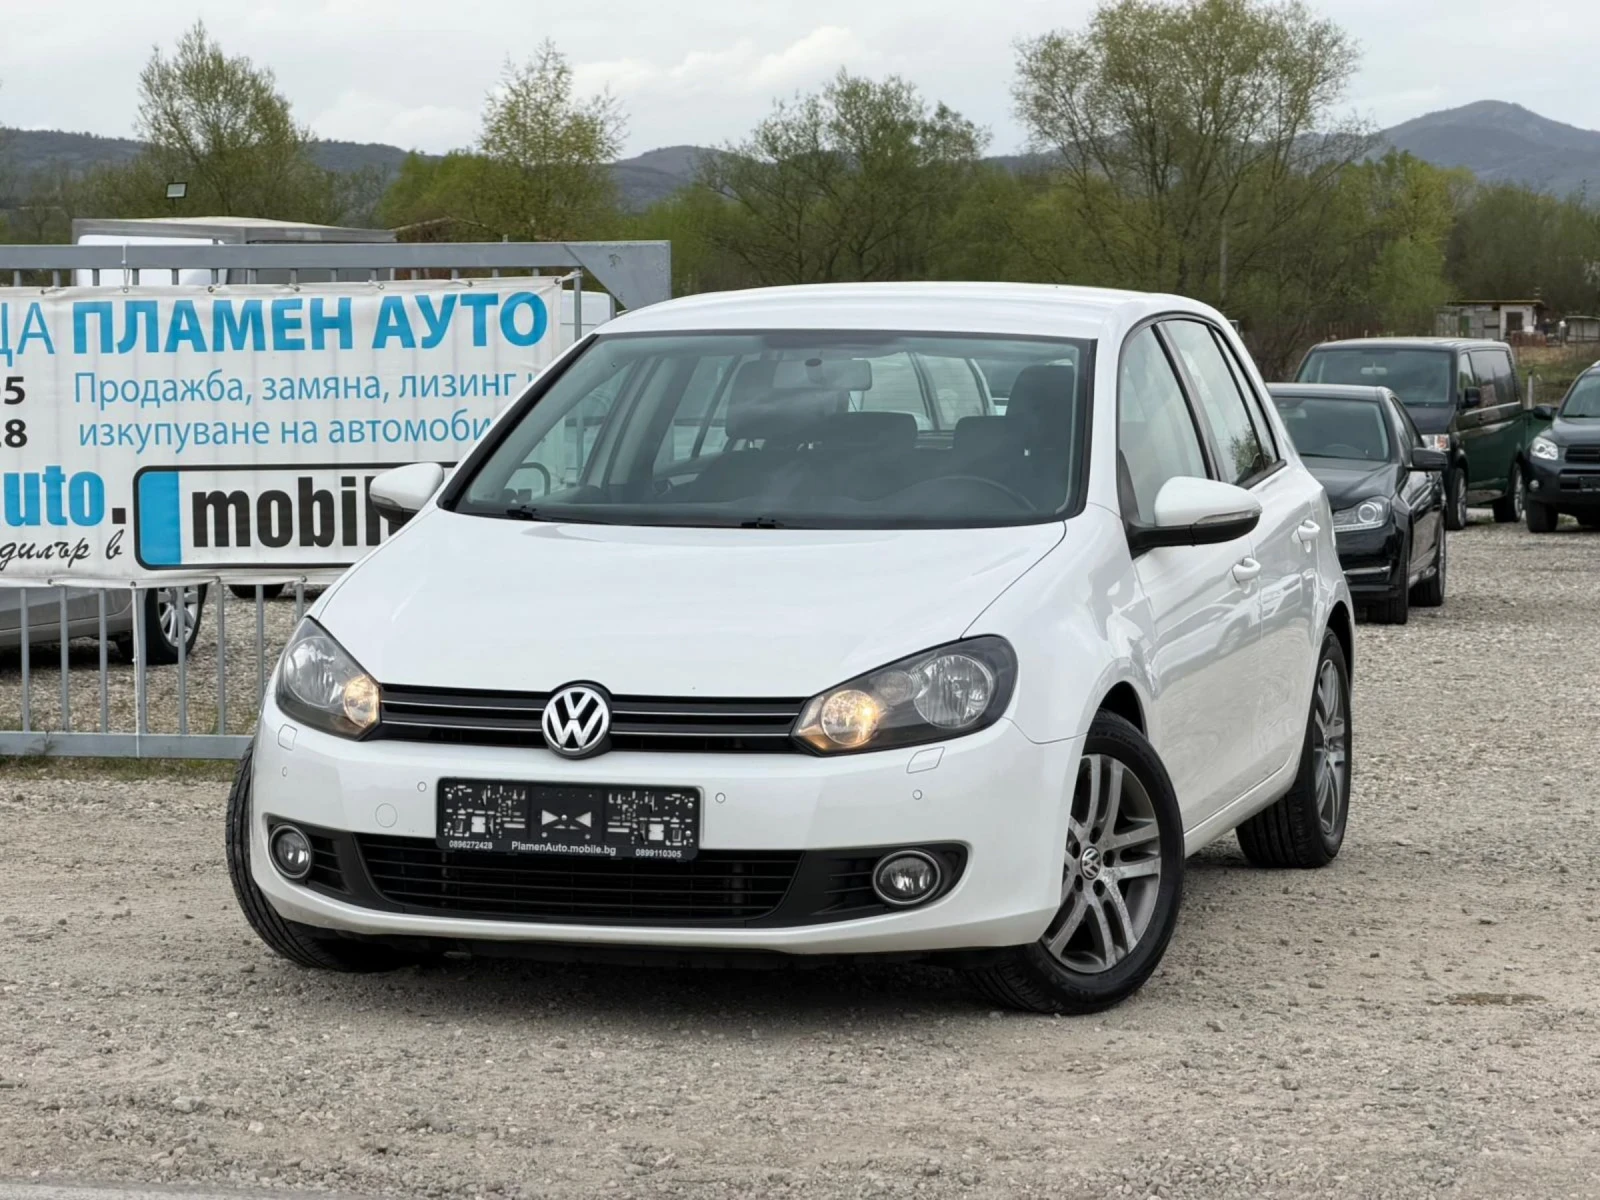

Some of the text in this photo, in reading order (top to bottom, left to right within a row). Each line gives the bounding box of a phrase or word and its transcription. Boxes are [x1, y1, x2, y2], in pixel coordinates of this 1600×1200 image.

[73, 297, 353, 354] ПЛАМЕН
[371, 291, 548, 350] АУТО
[0, 376, 26, 406] 5
[75, 369, 252, 411] Продажба,
[262, 375, 389, 404] замяна,
[398, 373, 516, 398] лизинг
[0, 418, 28, 449] 8
[79, 421, 270, 455] изкупуване
[281, 419, 317, 443] на
[192, 475, 402, 548] mobil
[511, 840, 617, 857] PlamenAuto.mobile.bg
